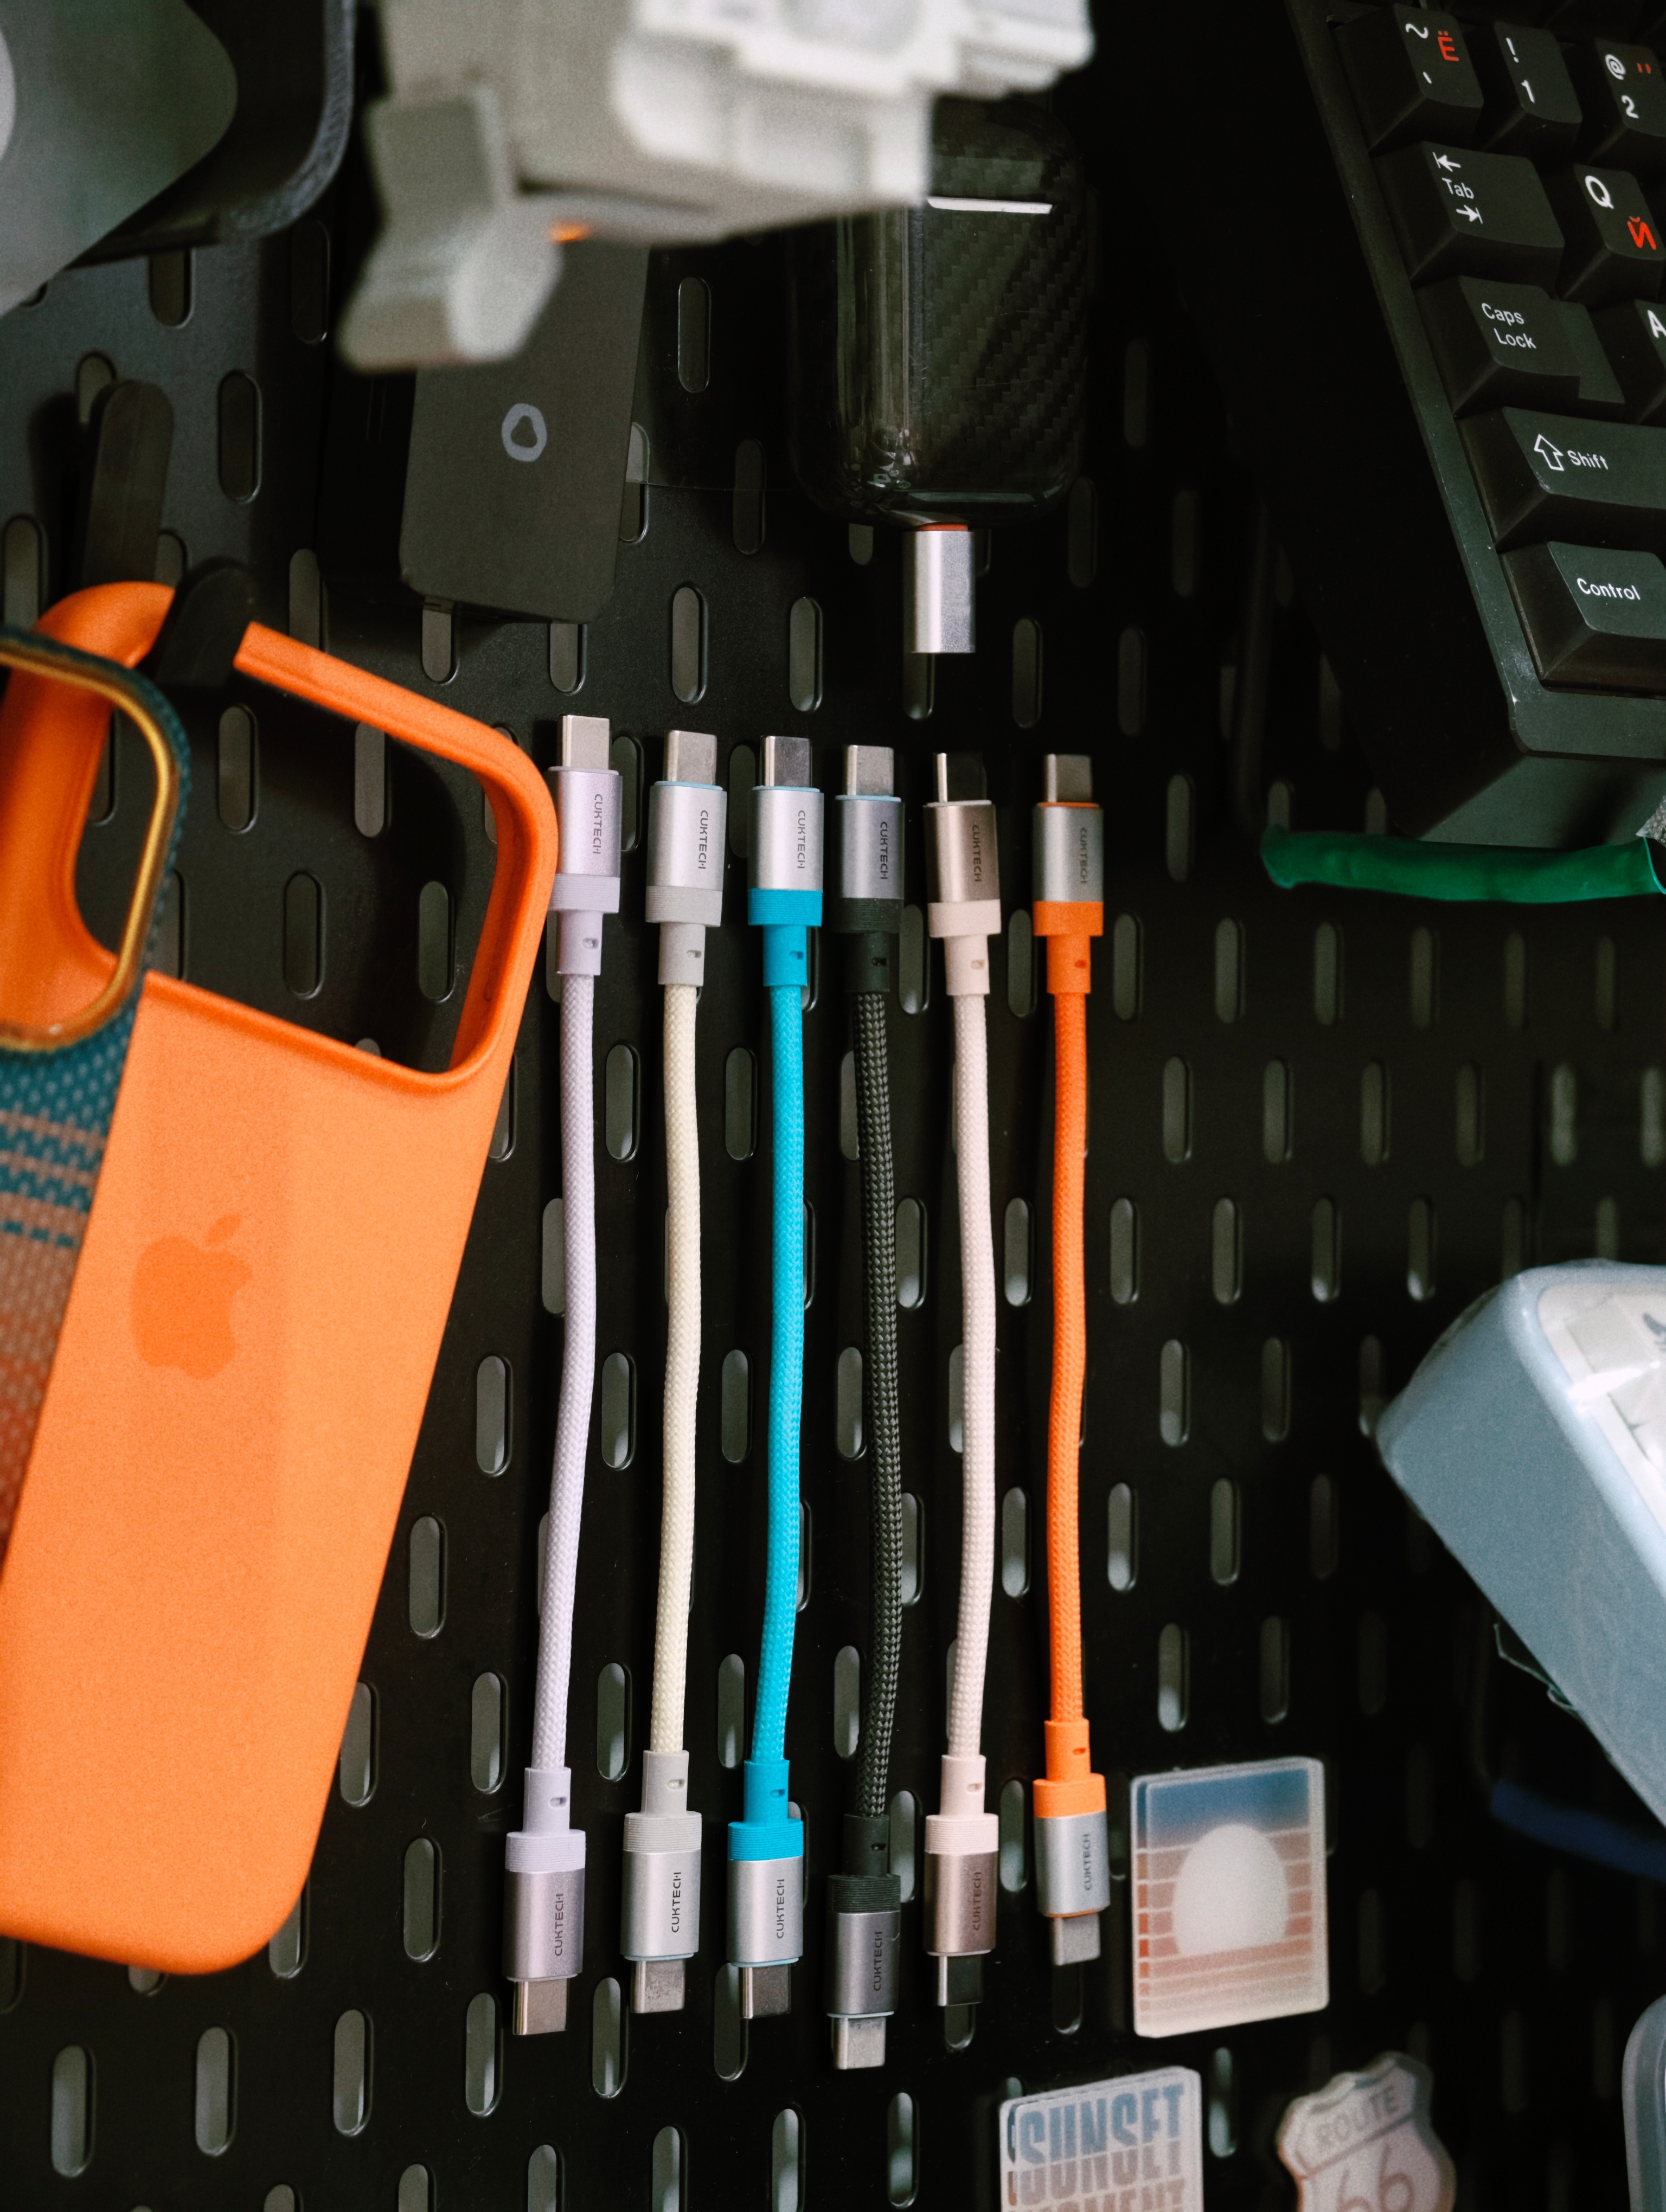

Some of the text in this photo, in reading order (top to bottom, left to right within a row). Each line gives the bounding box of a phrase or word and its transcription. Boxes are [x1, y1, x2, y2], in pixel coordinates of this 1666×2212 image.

[1437, 30, 1459, 62] Ё
[1505, 37, 1518, 62] !
[1604, 53, 1627, 81] @
[1521, 79, 1535, 103] 1
[1620, 95, 1639, 119] 2
[1441, 178, 1475, 201] Tab
[1584, 175, 1614, 210] Q
[1627, 216, 1656, 250] Й
[1482, 301, 1524, 326] Caps
[1494, 327, 1536, 350] Lock
[1567, 449, 1609, 472] Shift
[1577, 576, 1641, 602] Control
[593, 793, 603, 855] CUKTECH
[697, 809, 709, 870] CUKTECH
[796, 809, 806, 869] CUKTECH
[880, 821, 889, 880] CUKTECH
[971, 824, 982, 883] CUKTECH
[1079, 827, 1088, 884] CUKTECH
[1083, 1833, 1092, 1891] CUKTECH
[554, 1893, 565, 1957] CUKTECH
[670, 1871, 683, 1933] CUKTECH
[776, 1878, 785, 1939] CUKTECH
[971, 1871, 982, 1932] CUKTECH
[873, 1930, 883, 1992] CUKTECH
[1316, 2085, 1399, 2148] ROUTE
